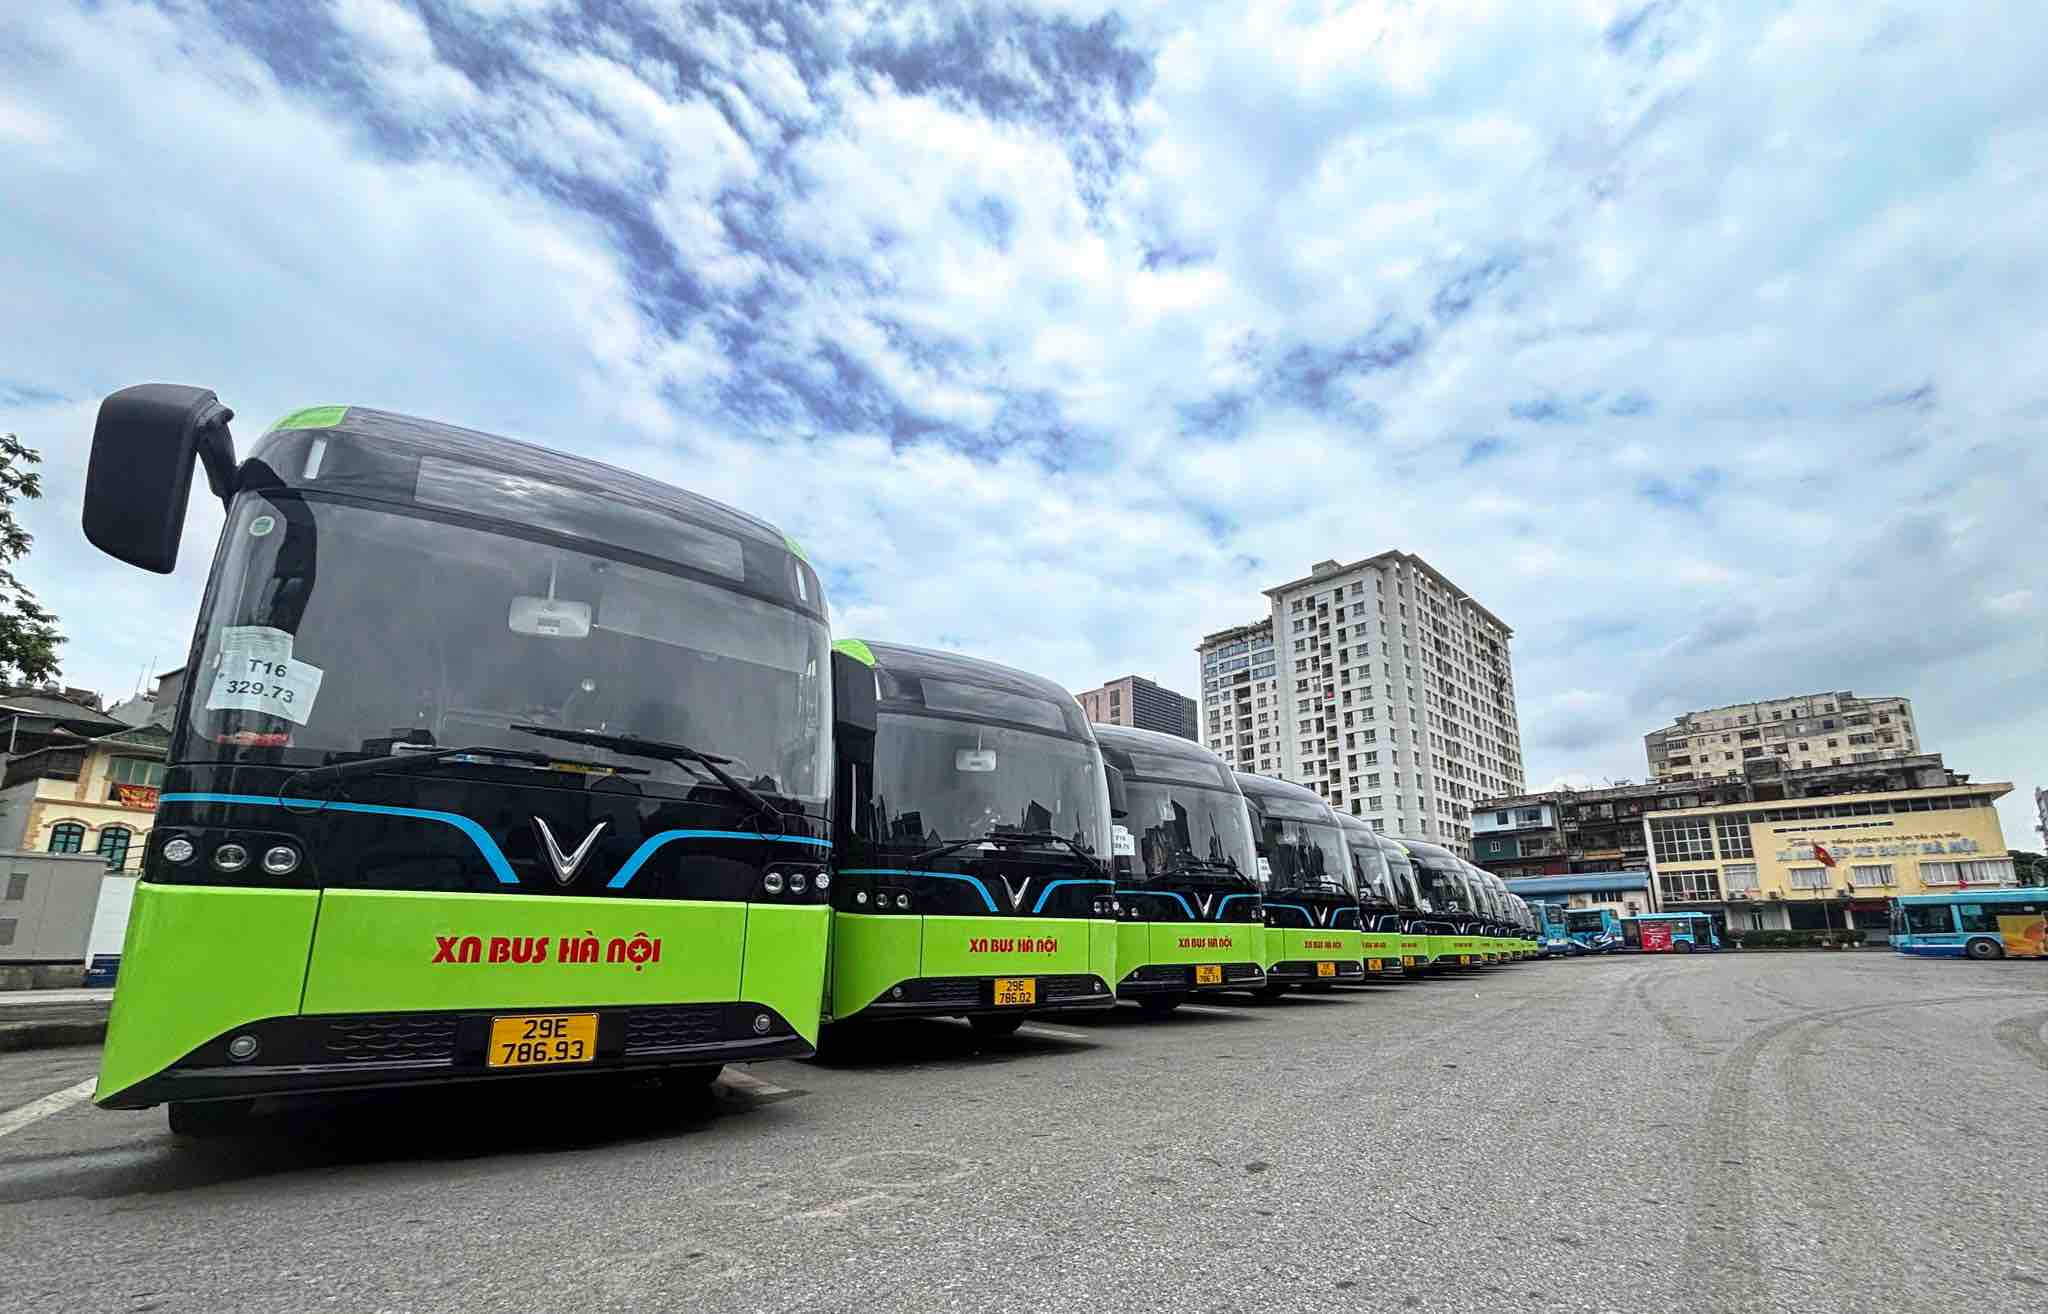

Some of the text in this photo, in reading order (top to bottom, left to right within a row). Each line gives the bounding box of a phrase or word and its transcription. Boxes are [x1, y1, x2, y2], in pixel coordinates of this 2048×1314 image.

[249, 659, 288, 678] T16
[226, 680, 294, 704] 329.73
[488, 936, 549, 963] BUS
[558, 931, 600, 963] HÀ
[991, 938, 1013, 952] BUS
[1017, 936, 1033, 952] HÀ
[1006, 980, 1024, 992] 29E
[522, 1018, 568, 1039] 29E
[501, 1040, 584, 1064] 786.93
